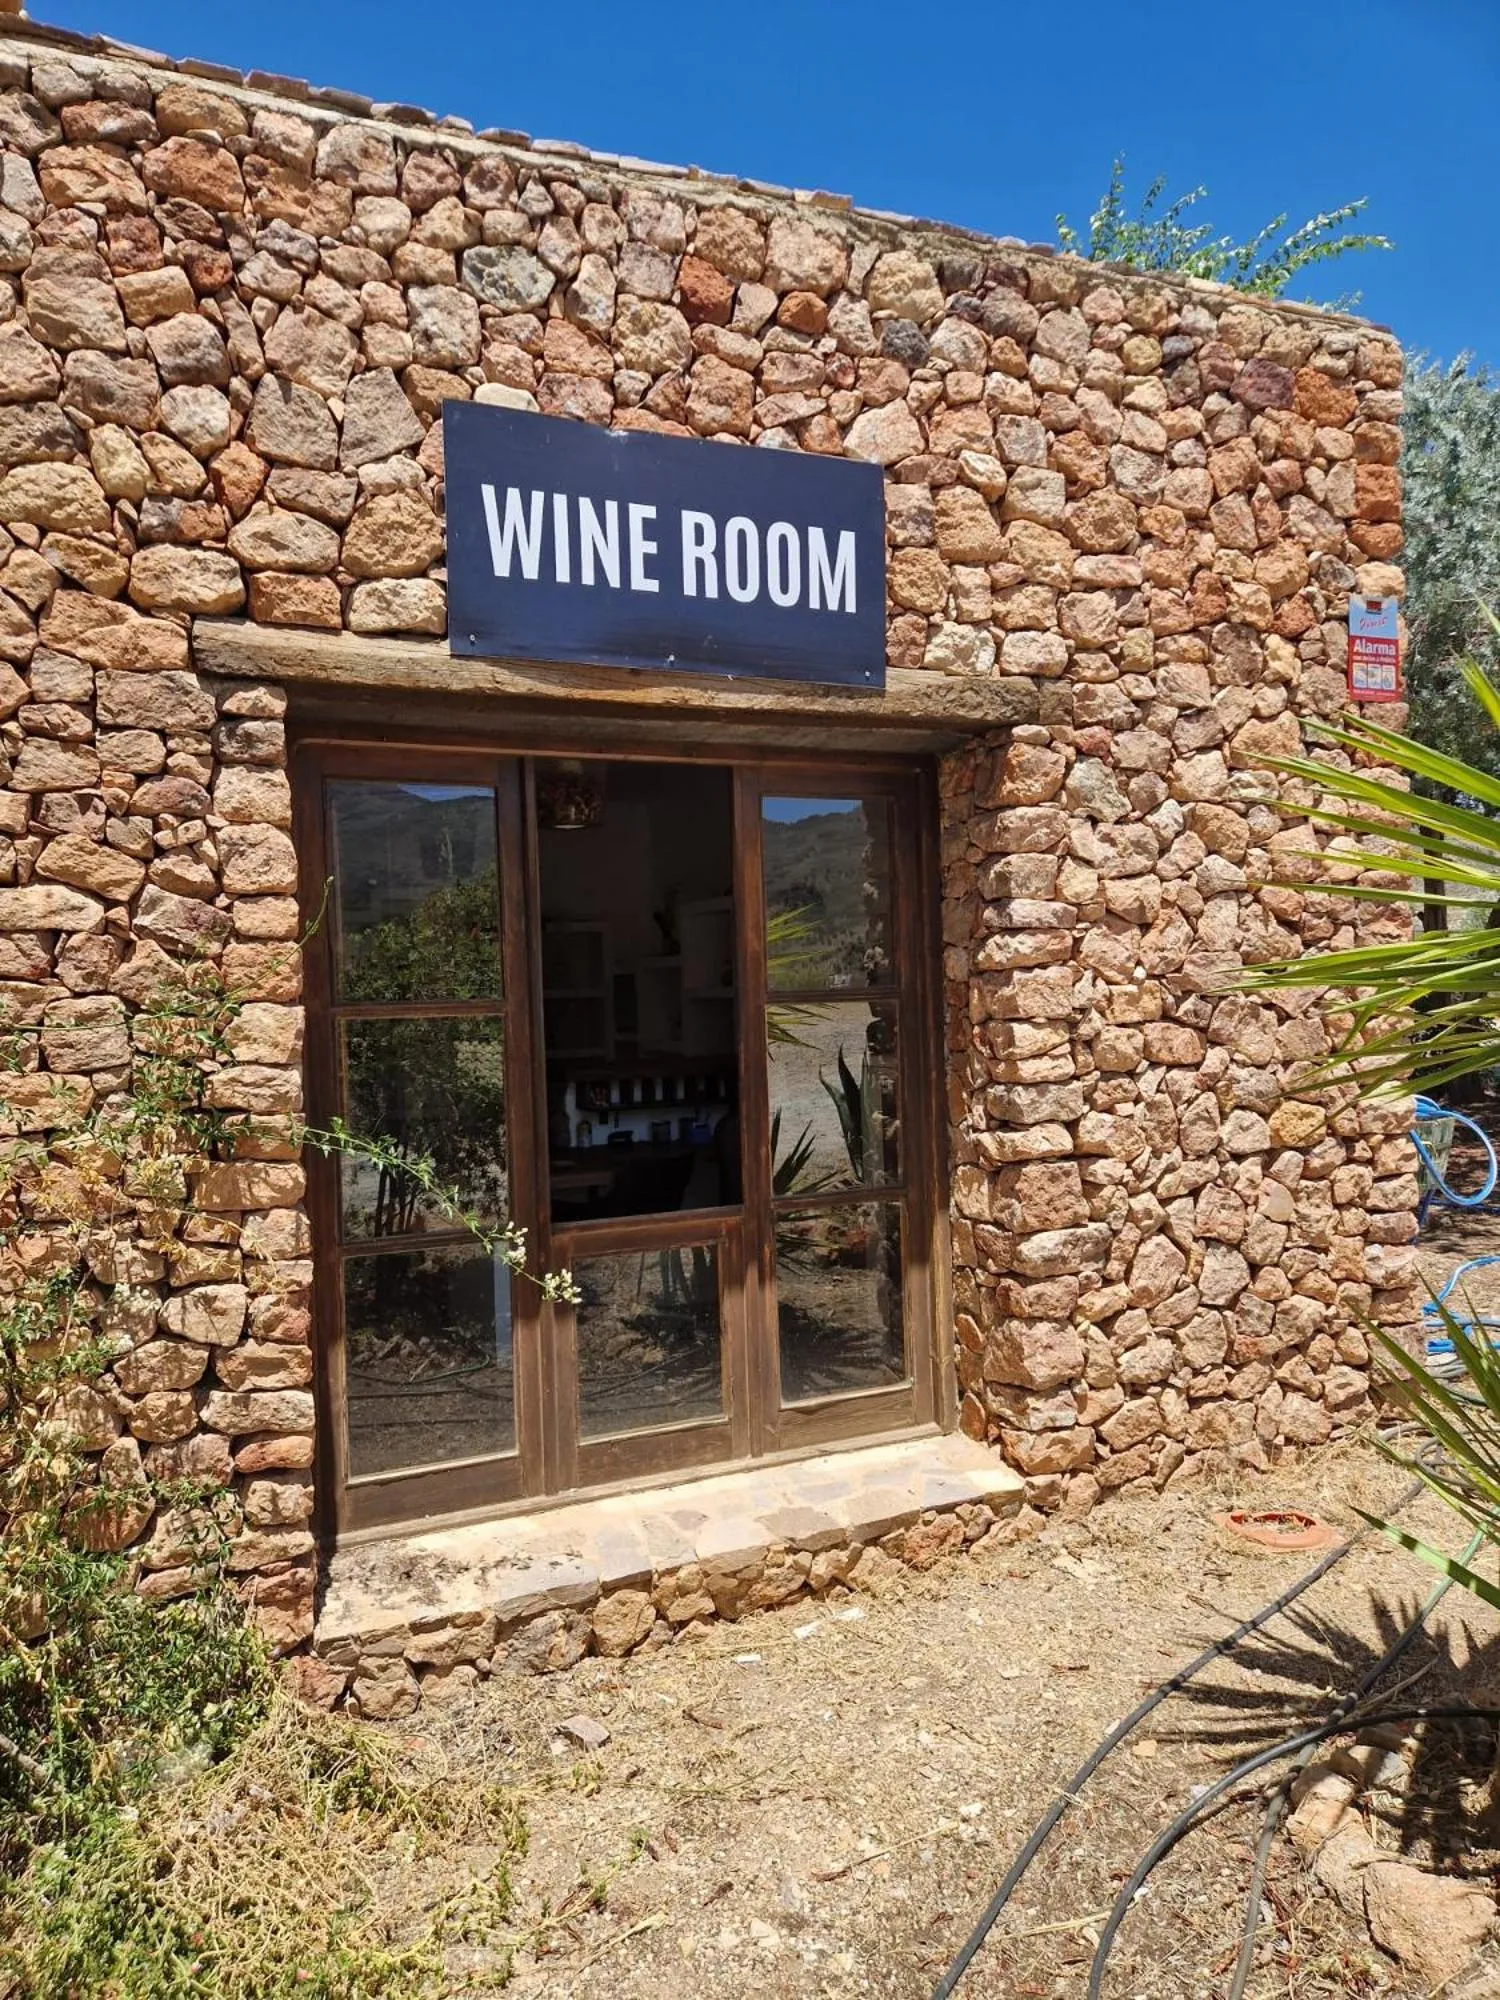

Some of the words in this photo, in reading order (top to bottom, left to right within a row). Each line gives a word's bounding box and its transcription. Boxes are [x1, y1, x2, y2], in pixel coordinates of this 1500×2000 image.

[481, 483, 660, 593] WINE
[681, 509, 857, 614] ROOM
[1353, 639, 1396, 656] Alarma
